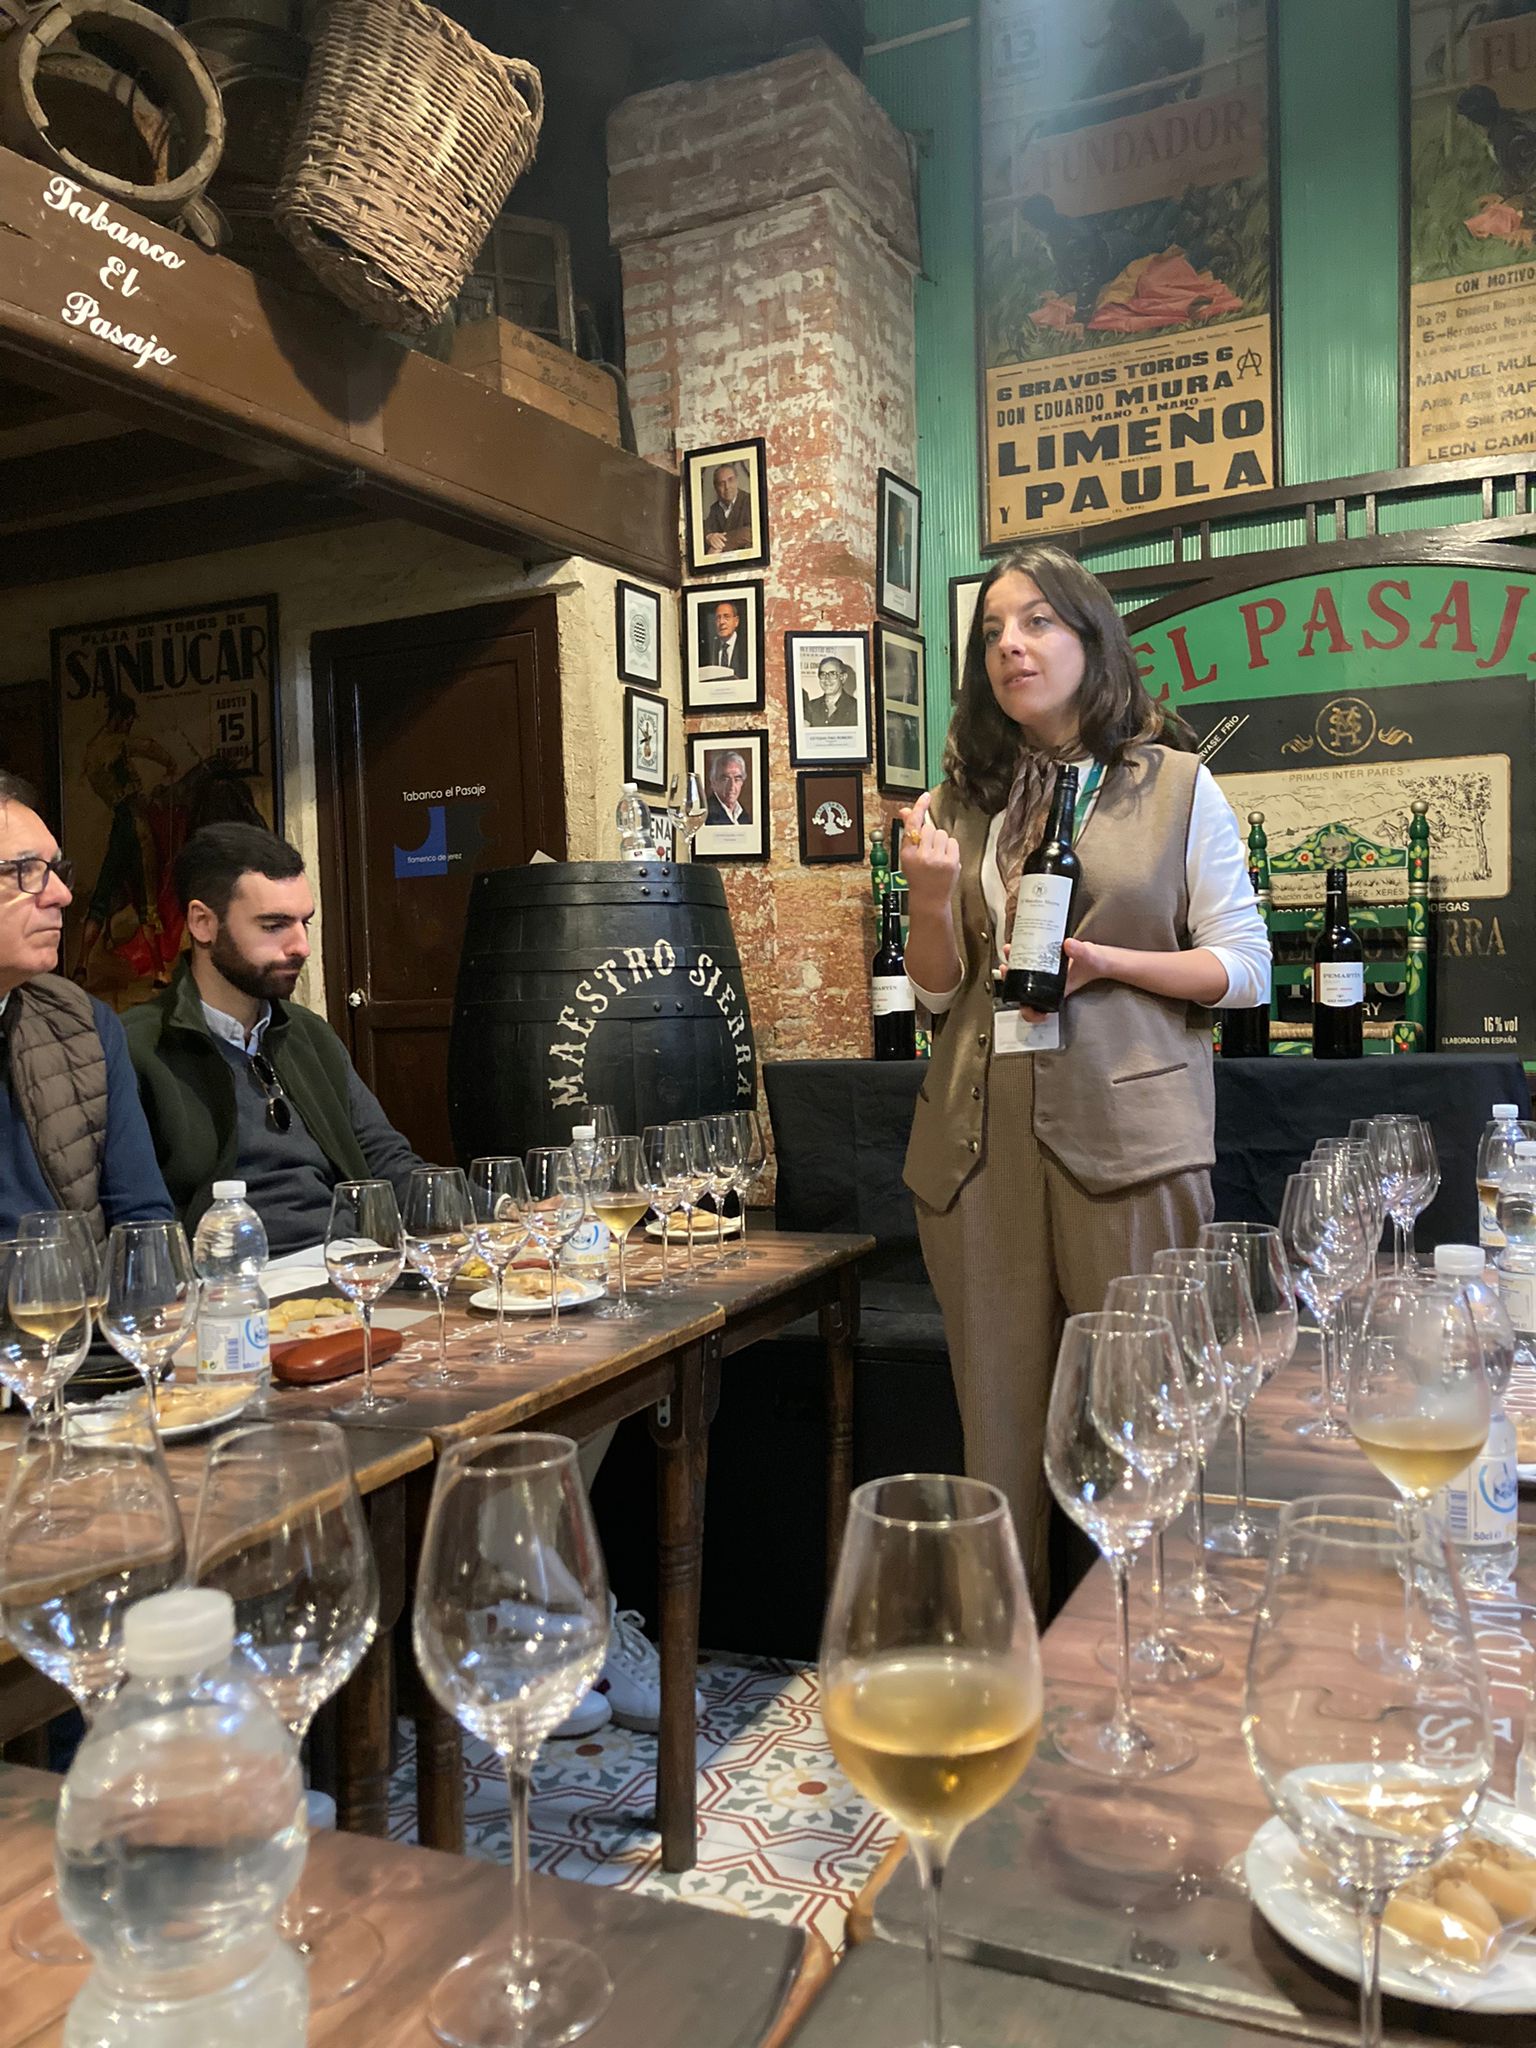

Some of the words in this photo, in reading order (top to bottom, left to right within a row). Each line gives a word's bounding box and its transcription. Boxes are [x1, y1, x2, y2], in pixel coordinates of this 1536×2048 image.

[43, 176, 186, 269] Tabanco
[99, 256, 141, 297] El
[1455, 278, 1480, 294] CON
[1488, 267, 1536, 288] MOTIVO
[61, 291, 177, 369] Pasaje
[996, 387, 1013, 402] 6
[1018, 368, 1117, 399] BRAVOS
[1123, 351, 1209, 385] TOROS
[1215, 346, 1234, 363] 6
[1416, 362, 1492, 388] MANUEL
[1497, 354, 1536, 373] MUL
[996, 406, 1026, 428] DON
[1034, 393, 1104, 423] EDUARDO
[1114, 370, 1234, 408] MIURA
[1091, 409, 1132, 424] MANO
[1139, 406, 1150, 415] A
[1156, 397, 1199, 411] MANO
[998, 399, 1265, 477] LIMEÑO
[1426, 441, 1477, 461] LEON
[1484, 429, 1536, 452] CAMI
[998, 506, 1011, 525] Y
[1025, 450, 1267, 521] PAULA
[63, 624, 268, 701] SANLUCAR
[1134, 626, 1218, 706] EL
[217, 711, 245, 743] 15
[1199, 734, 1223, 758] RVASE
[1219, 714, 1240, 736] FRIO
[402, 790, 443, 802] Tabanco
[445, 786, 454, 798] el
[455, 783, 487, 797] Pasaje
[1288, 771, 1330, 783] PRIMUS
[1331, 769, 1365, 780] INTER
[1367, 766, 1405, 778] PARES
[1347, 889, 1369, 898] EREZ
[1375, 887, 1405, 897] XERES
[1428, 901, 1470, 913] DEGAS
[1441, 916, 1507, 958] RRA
[548, 938, 677, 1110] MAESTRO
[689, 953, 752, 1097] SIERRA
[1441, 1035, 1480, 1046] ELABORADO
[1480, 1035, 1490, 1045] EN
[1490, 1034, 1518, 1045] ESPAÑA
[1503, 1015, 1519, 1033] vol
